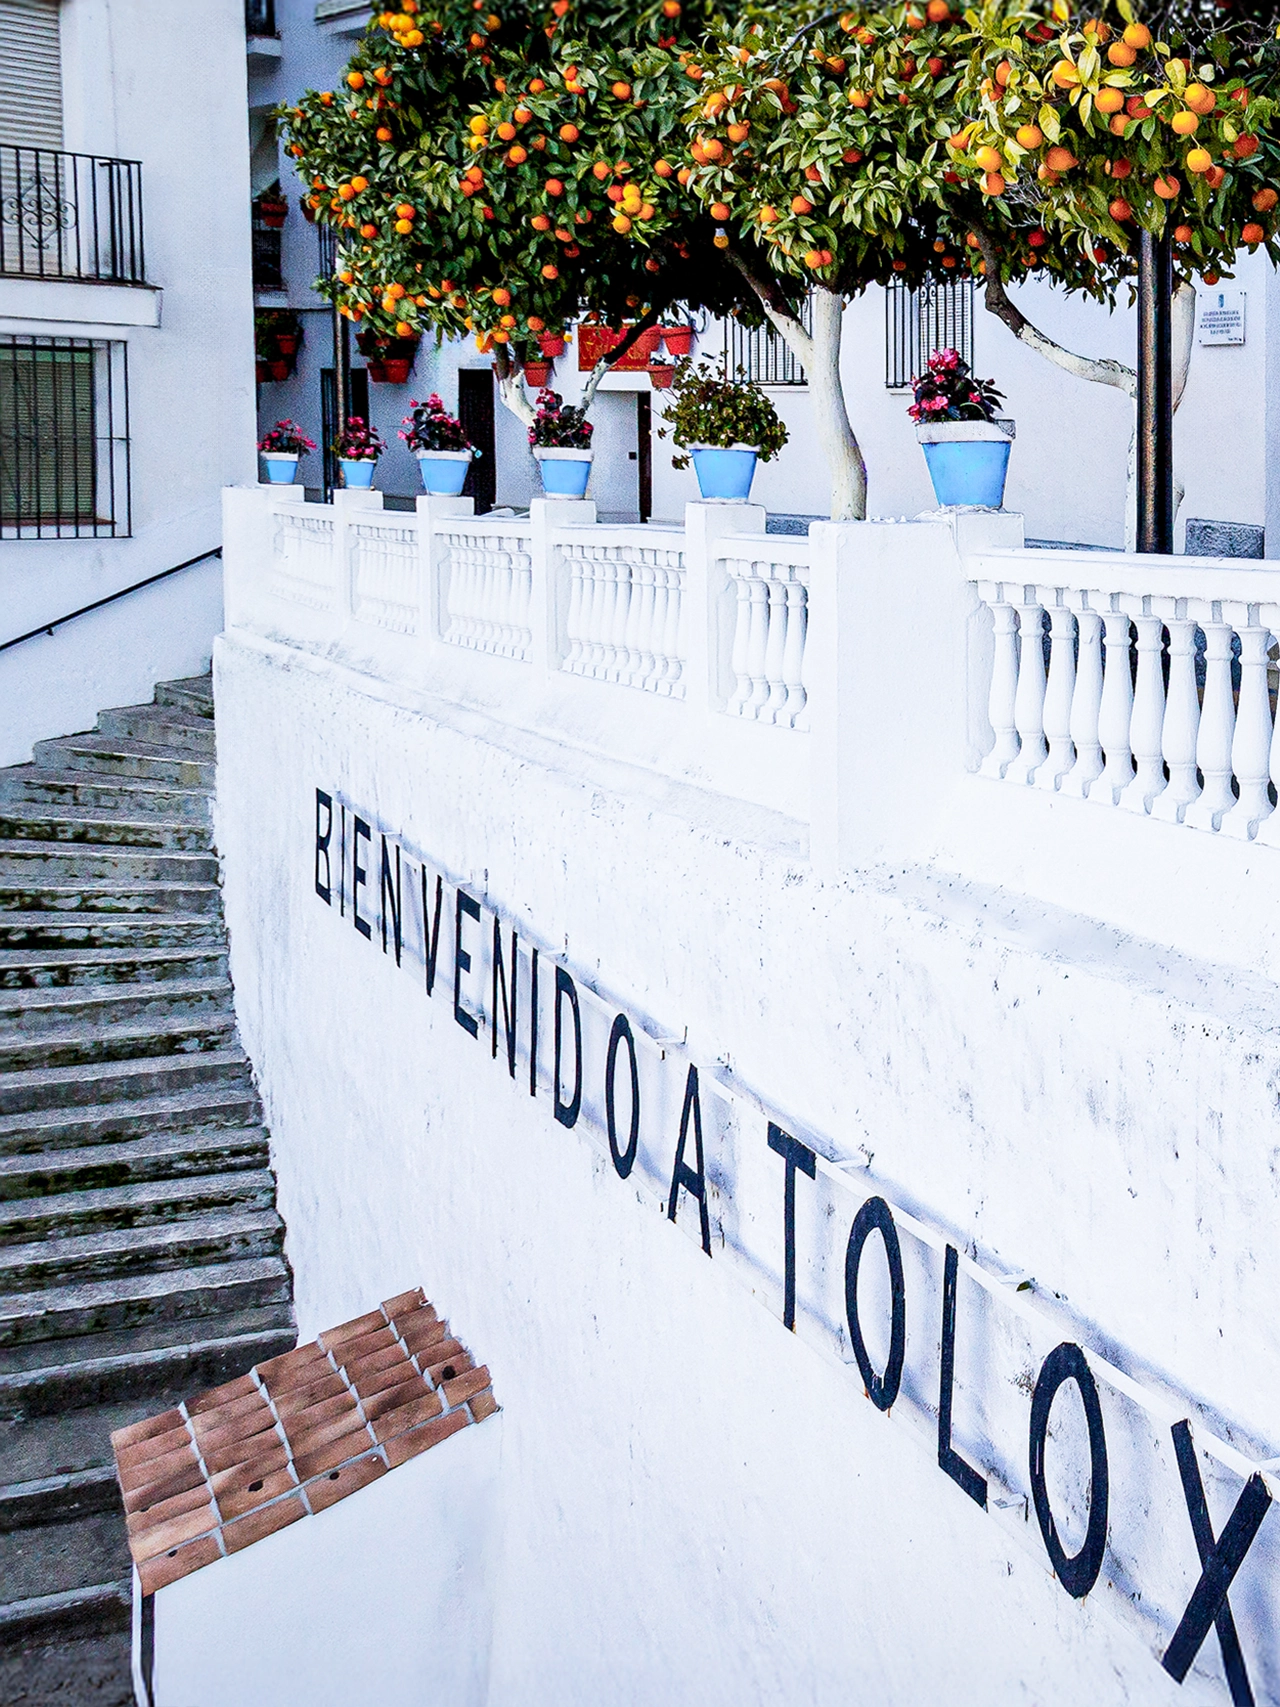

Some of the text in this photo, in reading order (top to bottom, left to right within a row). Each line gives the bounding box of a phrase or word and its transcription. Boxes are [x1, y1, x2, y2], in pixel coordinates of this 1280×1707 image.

[315, 787, 1273, 1707] BIENVENIDO A TOLOX
